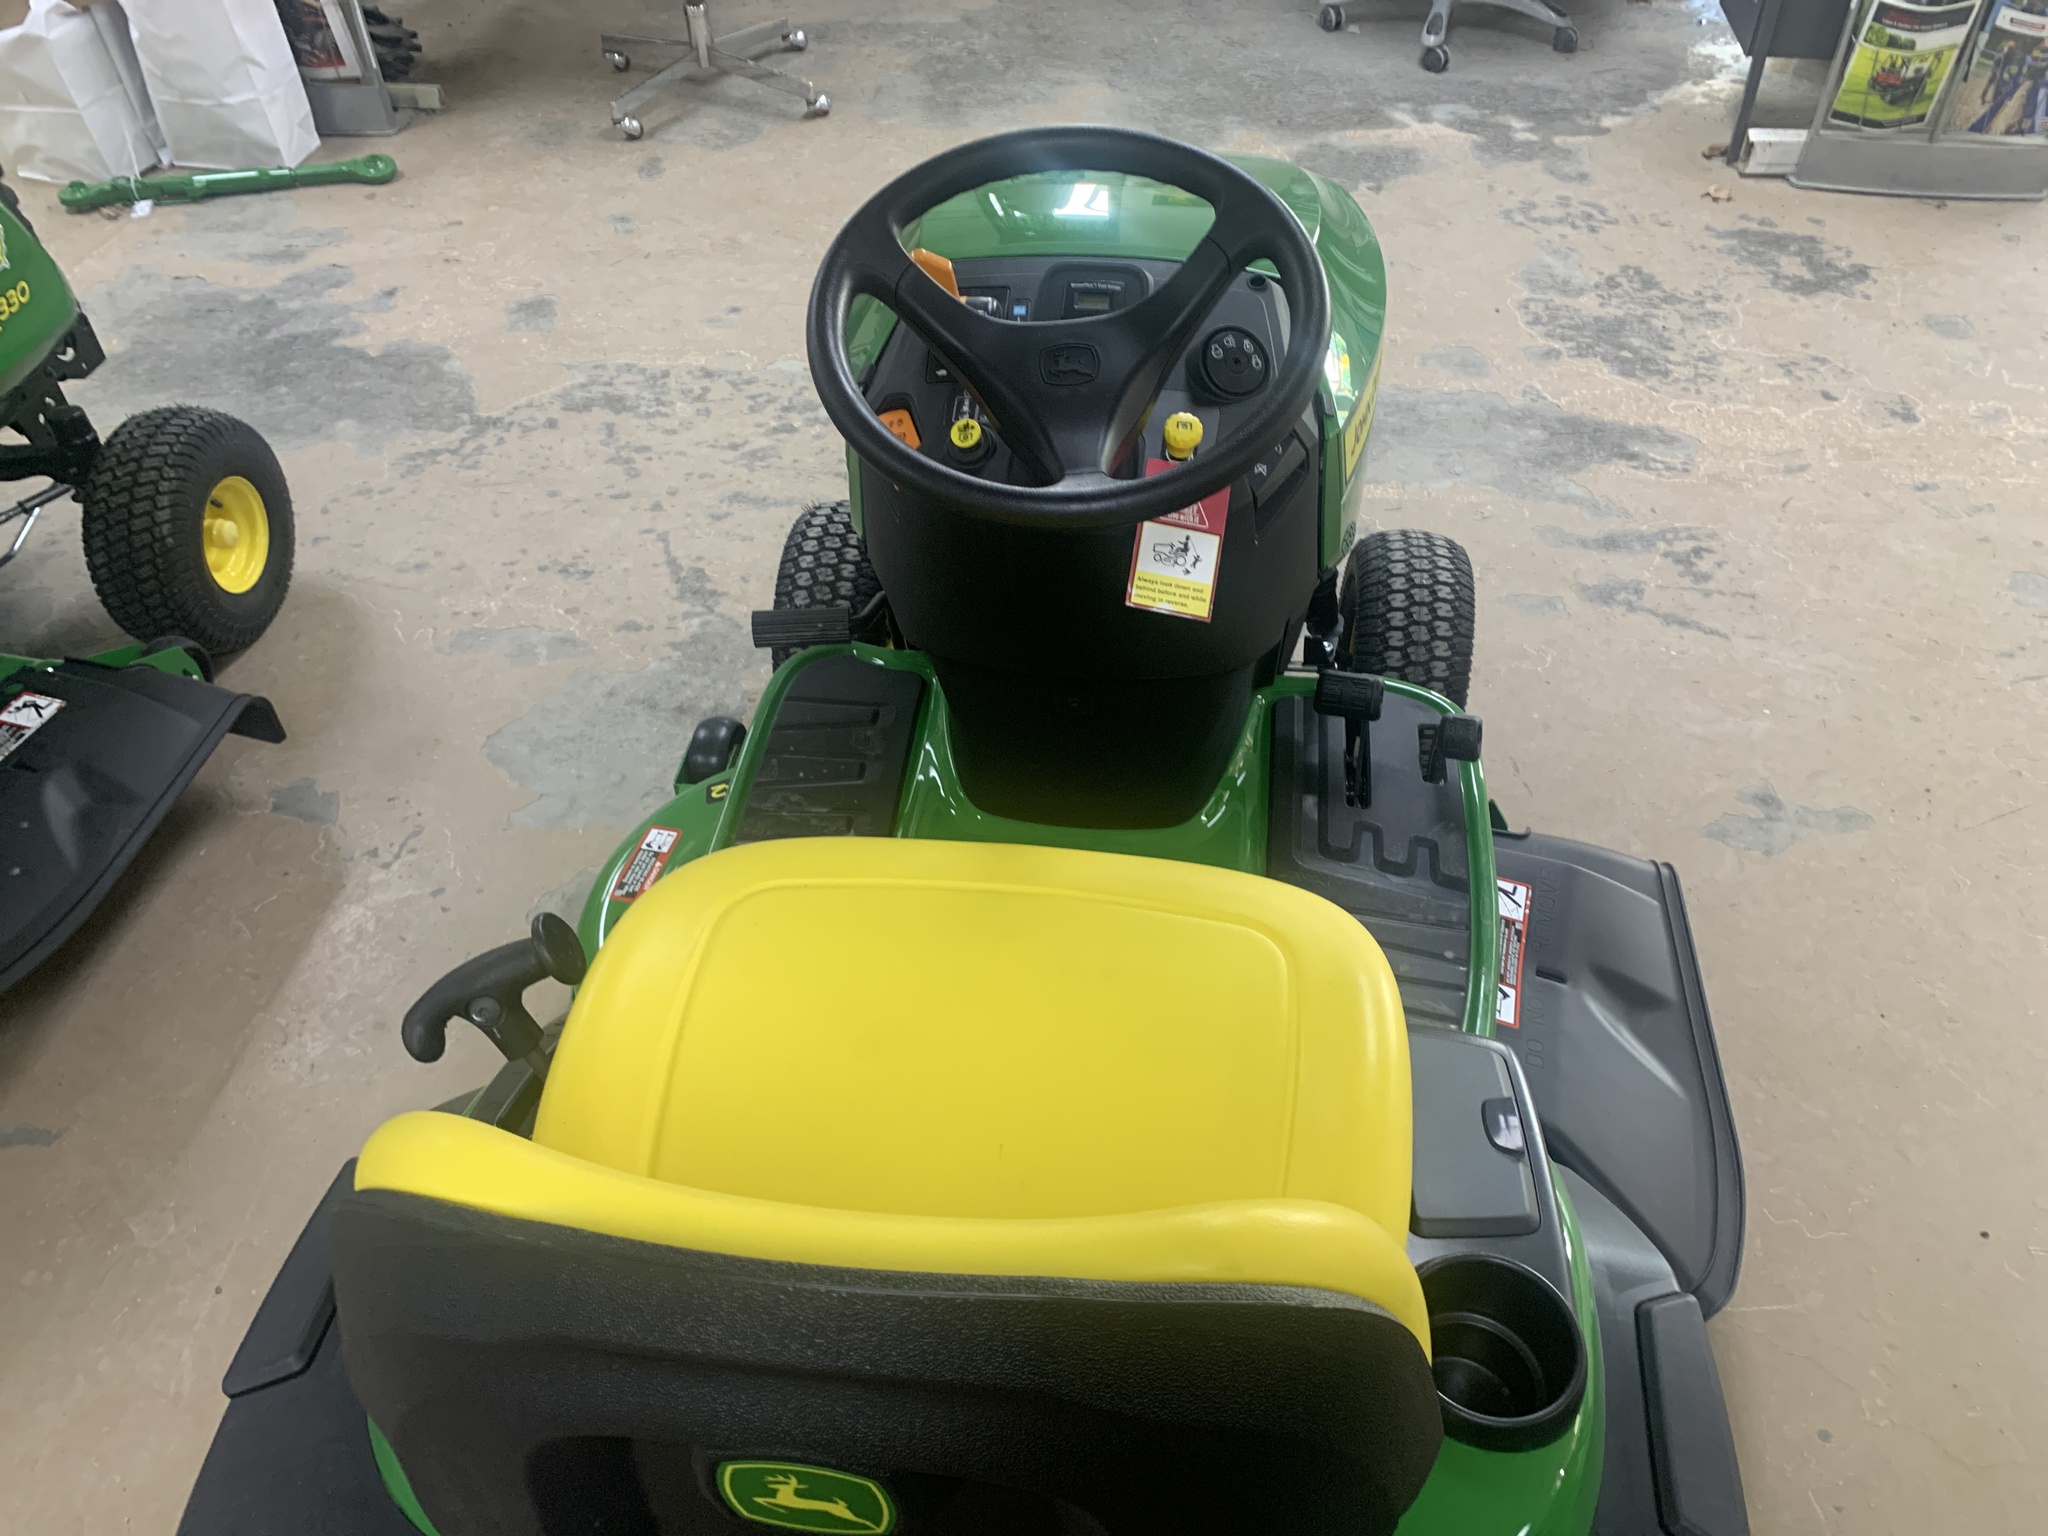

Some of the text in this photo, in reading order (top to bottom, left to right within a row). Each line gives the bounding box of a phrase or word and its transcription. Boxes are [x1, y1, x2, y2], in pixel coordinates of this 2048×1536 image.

[1137, 576, 1158, 585] Always
[1160, 579, 1173, 587] look
[1135, 584, 1157, 593] behind
[1158, 588, 1177, 597] before
[1178, 592, 1190, 600] and
